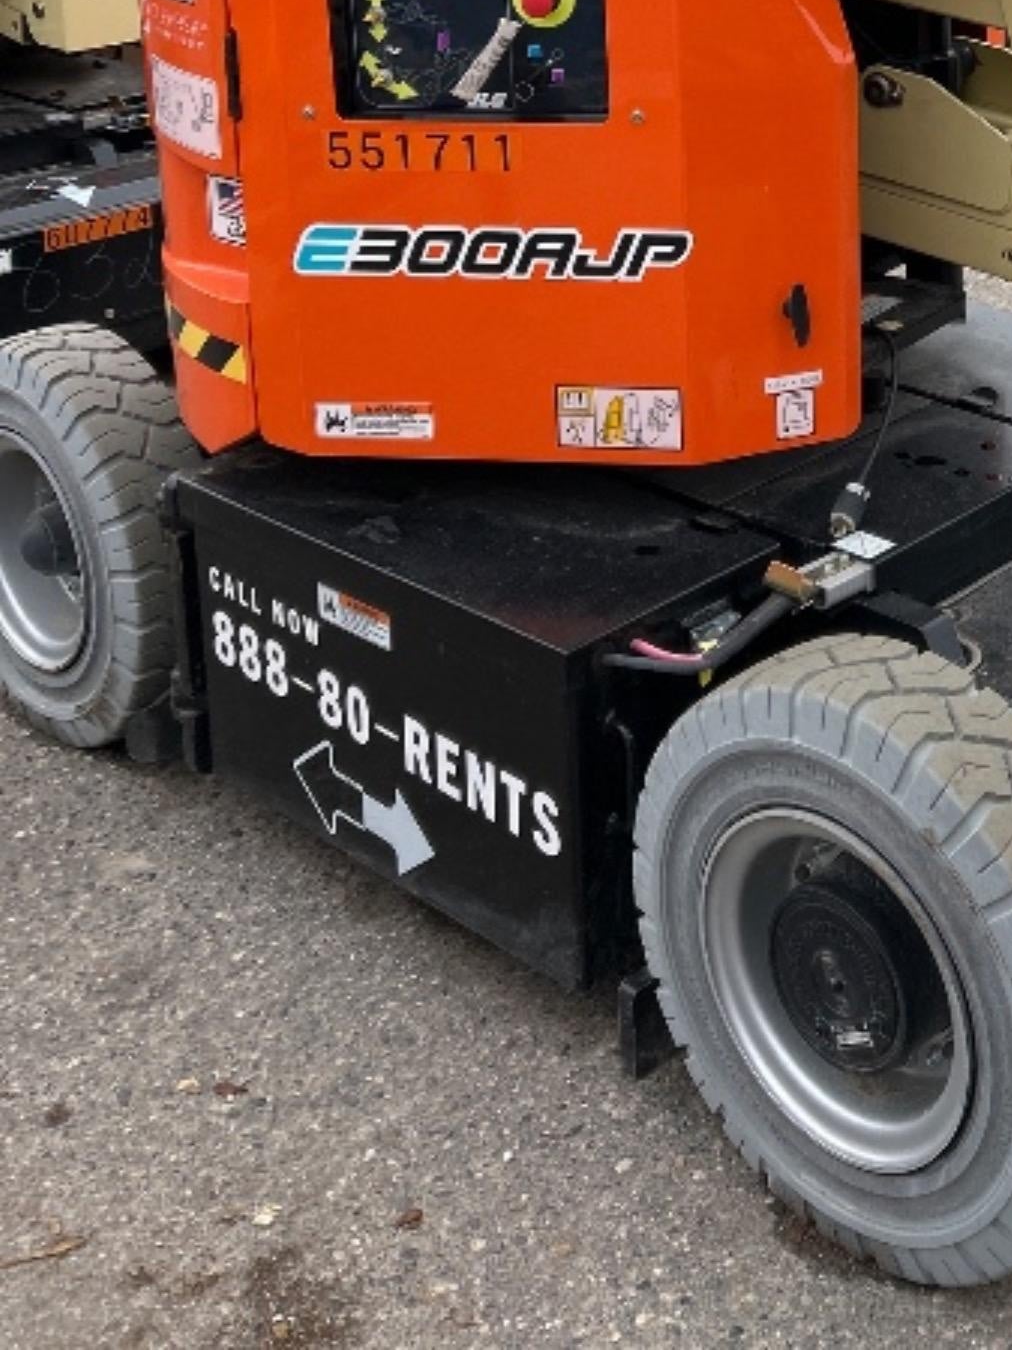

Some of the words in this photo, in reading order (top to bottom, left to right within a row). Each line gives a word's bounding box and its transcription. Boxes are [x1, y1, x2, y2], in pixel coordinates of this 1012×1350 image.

[328, 131, 511, 172] 551711
[294, 222, 693, 281] E300AJP
[208, 566, 262, 615] CALL
[271, 598, 320, 647] NOW
[211, 610, 563, 856] 888-80-RENTS
